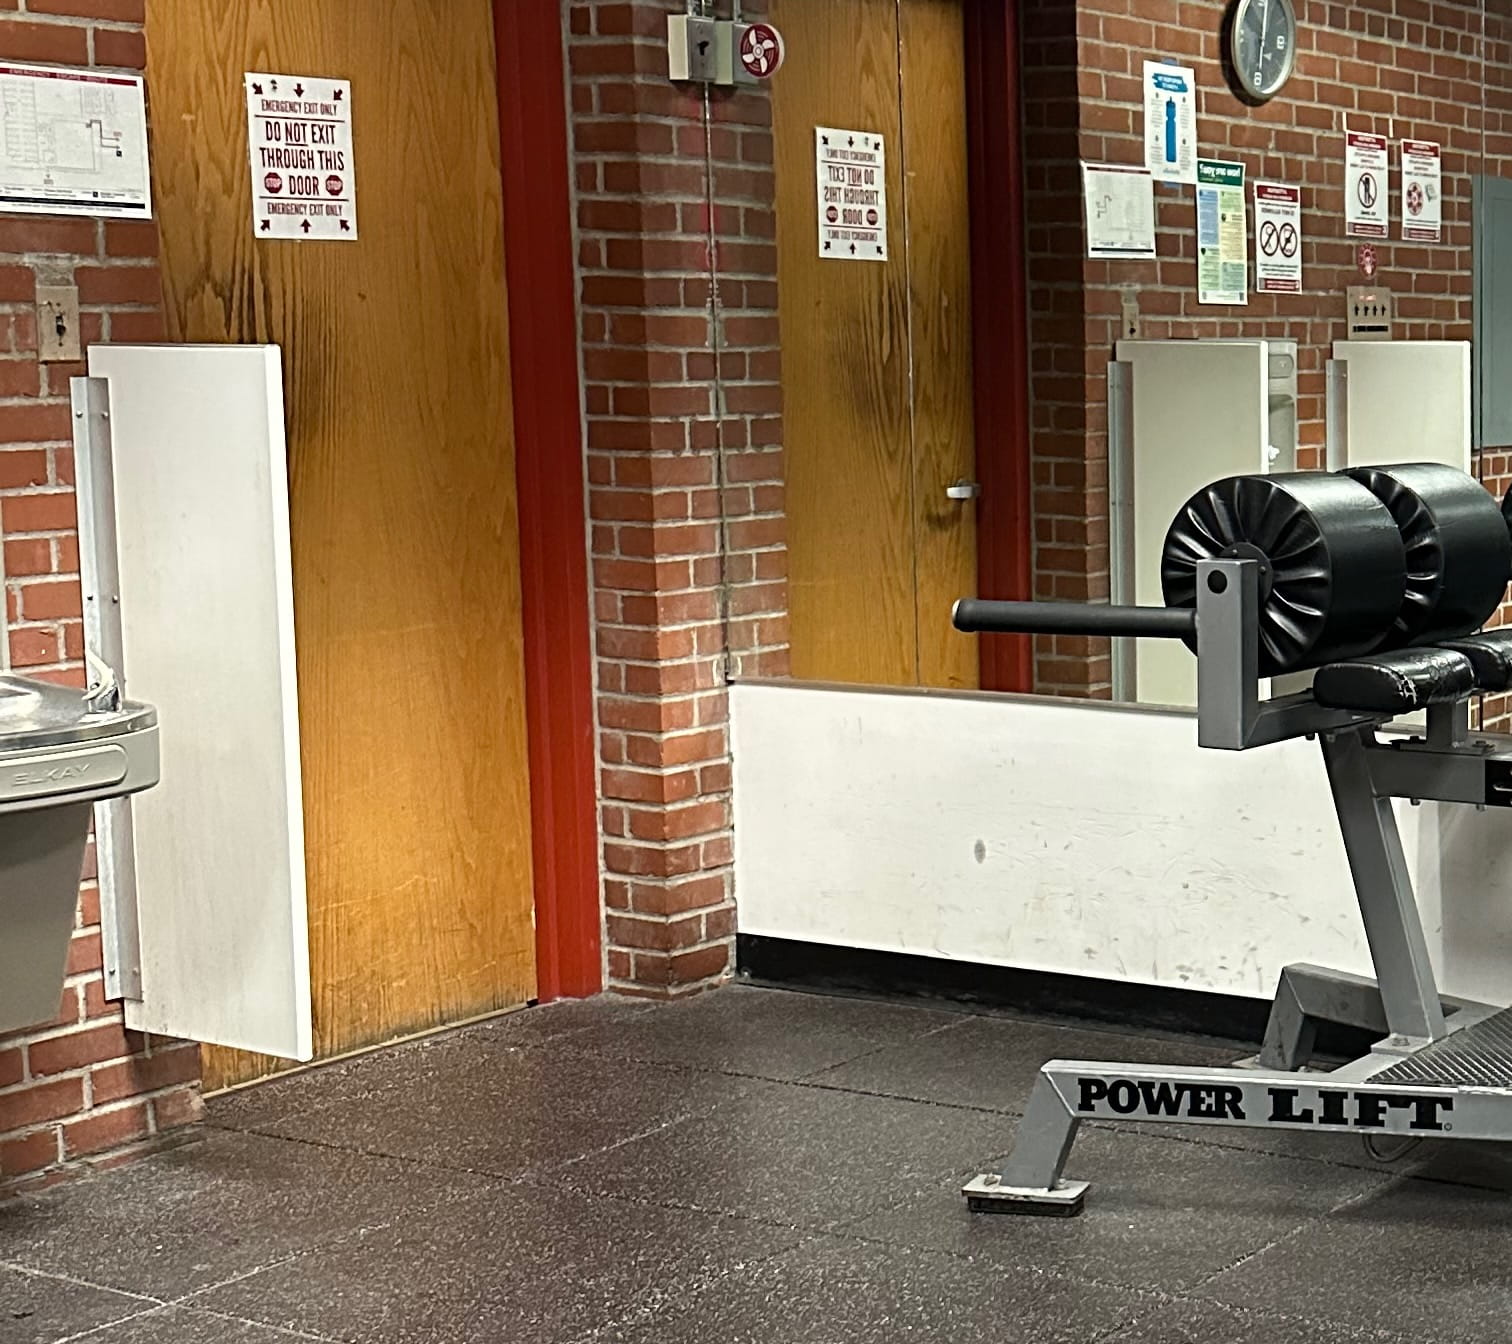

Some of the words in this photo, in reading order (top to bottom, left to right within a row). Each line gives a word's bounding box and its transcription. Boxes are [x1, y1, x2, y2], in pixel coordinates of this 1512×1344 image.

[262, 99, 301, 114] EMERGENCY
[304, 102, 318, 114] EXIT
[320, 103, 337, 116] ONLY
[265, 121, 281, 142] DO
[285, 122, 307, 143] NOT
[311, 124, 336, 145] EXIT
[259, 147, 315, 170] THROUGH
[318, 150, 344, 171] THIS
[289, 175, 320, 196] DOOR
[267, 202, 308, 216] EMERGENCY
[309, 203, 324, 216] EXIT
[325, 204, 342, 217] ONLY
[12, 762, 90, 787] ELKAY
[1077, 1077, 1246, 1120] POWER
[1268, 1088, 1454, 1131] LIFT
